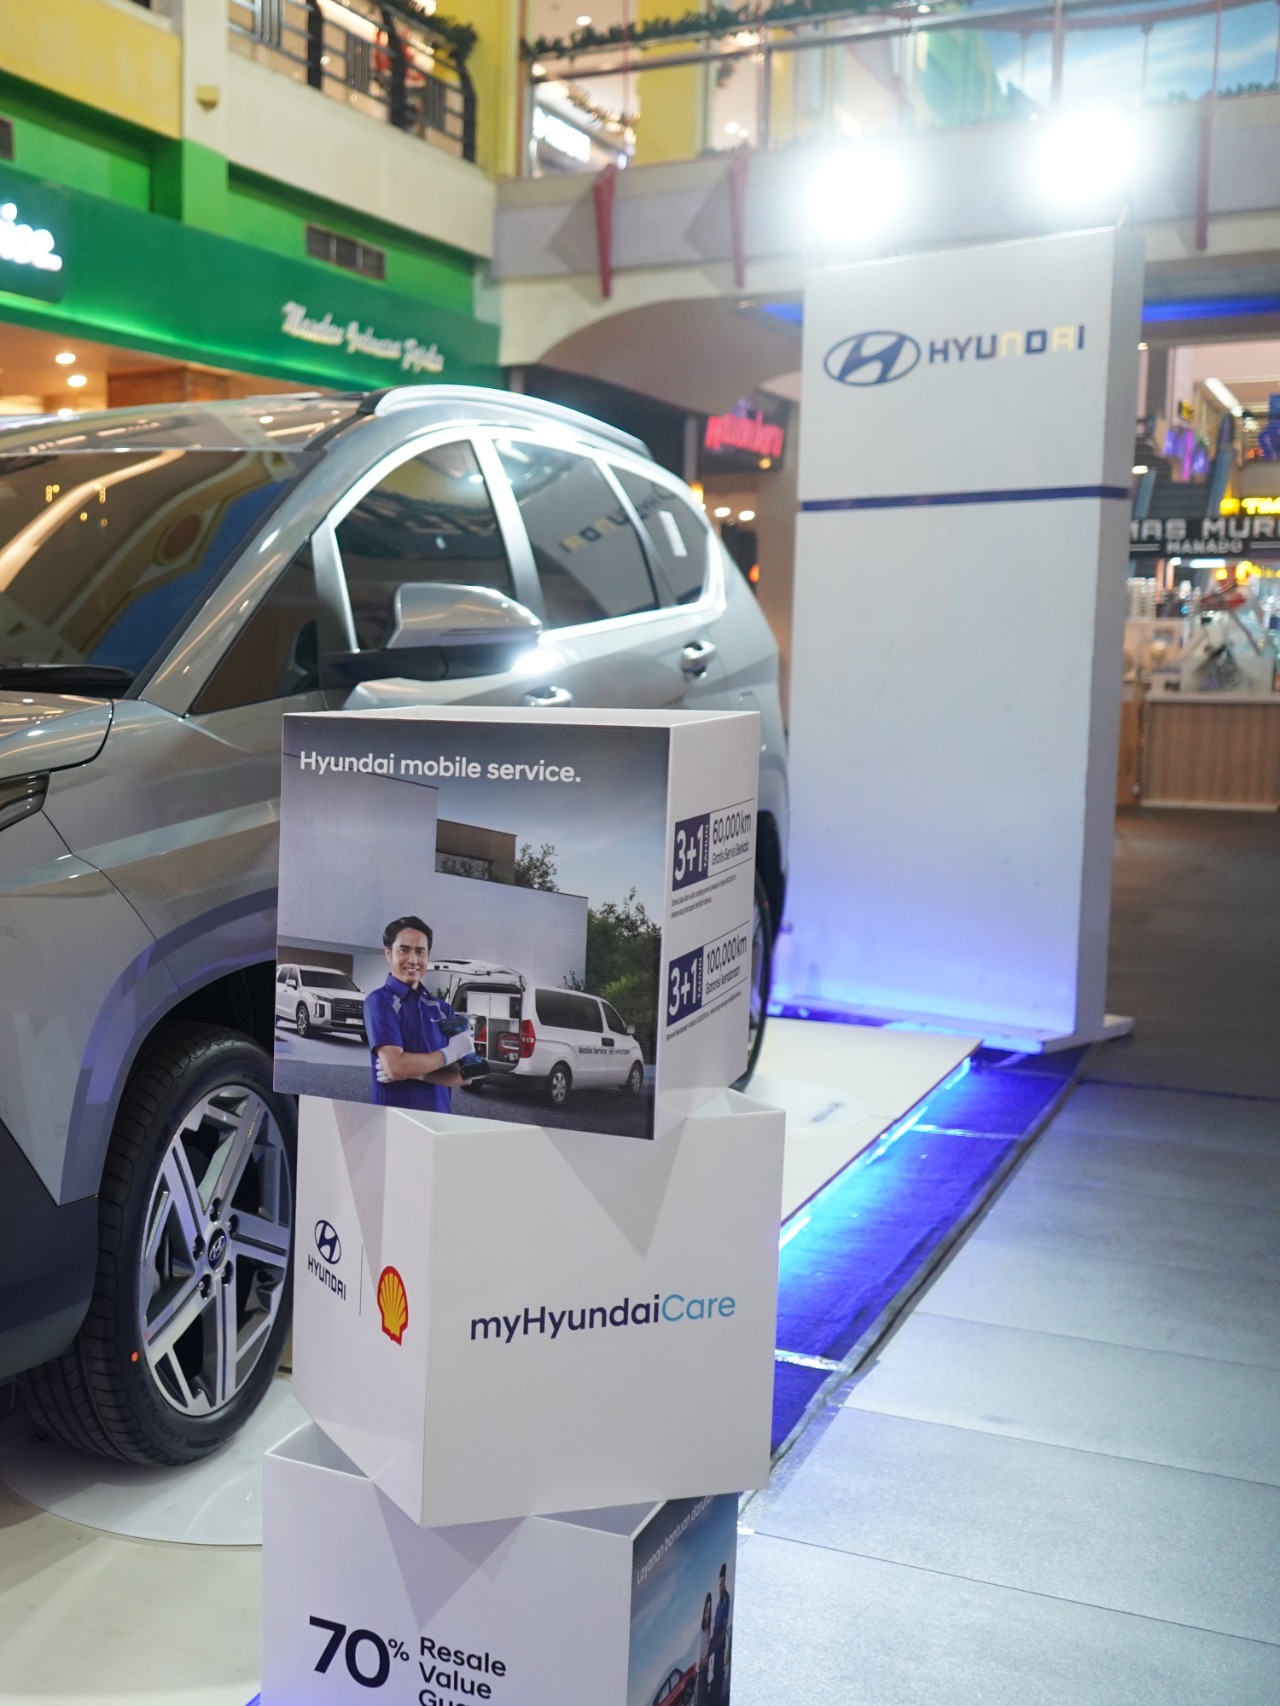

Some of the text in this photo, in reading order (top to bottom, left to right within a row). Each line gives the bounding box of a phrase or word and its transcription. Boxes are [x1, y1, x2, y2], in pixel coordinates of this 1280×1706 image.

[929, 325, 1084, 364] HYUNDAI
[1202, 517, 1280, 540] MUR
[300, 751, 581, 783] Hyundai mobile service.
[674, 824, 704, 881] 3+1
[669, 958, 697, 1016] 3+1
[308, 1254, 346, 1301] HYUNDAI
[471, 1294, 736, 1343] myHyundaiCare
[309, 1615, 506, 1688] 70% Resale
[418, 1661, 492, 1699] Value
